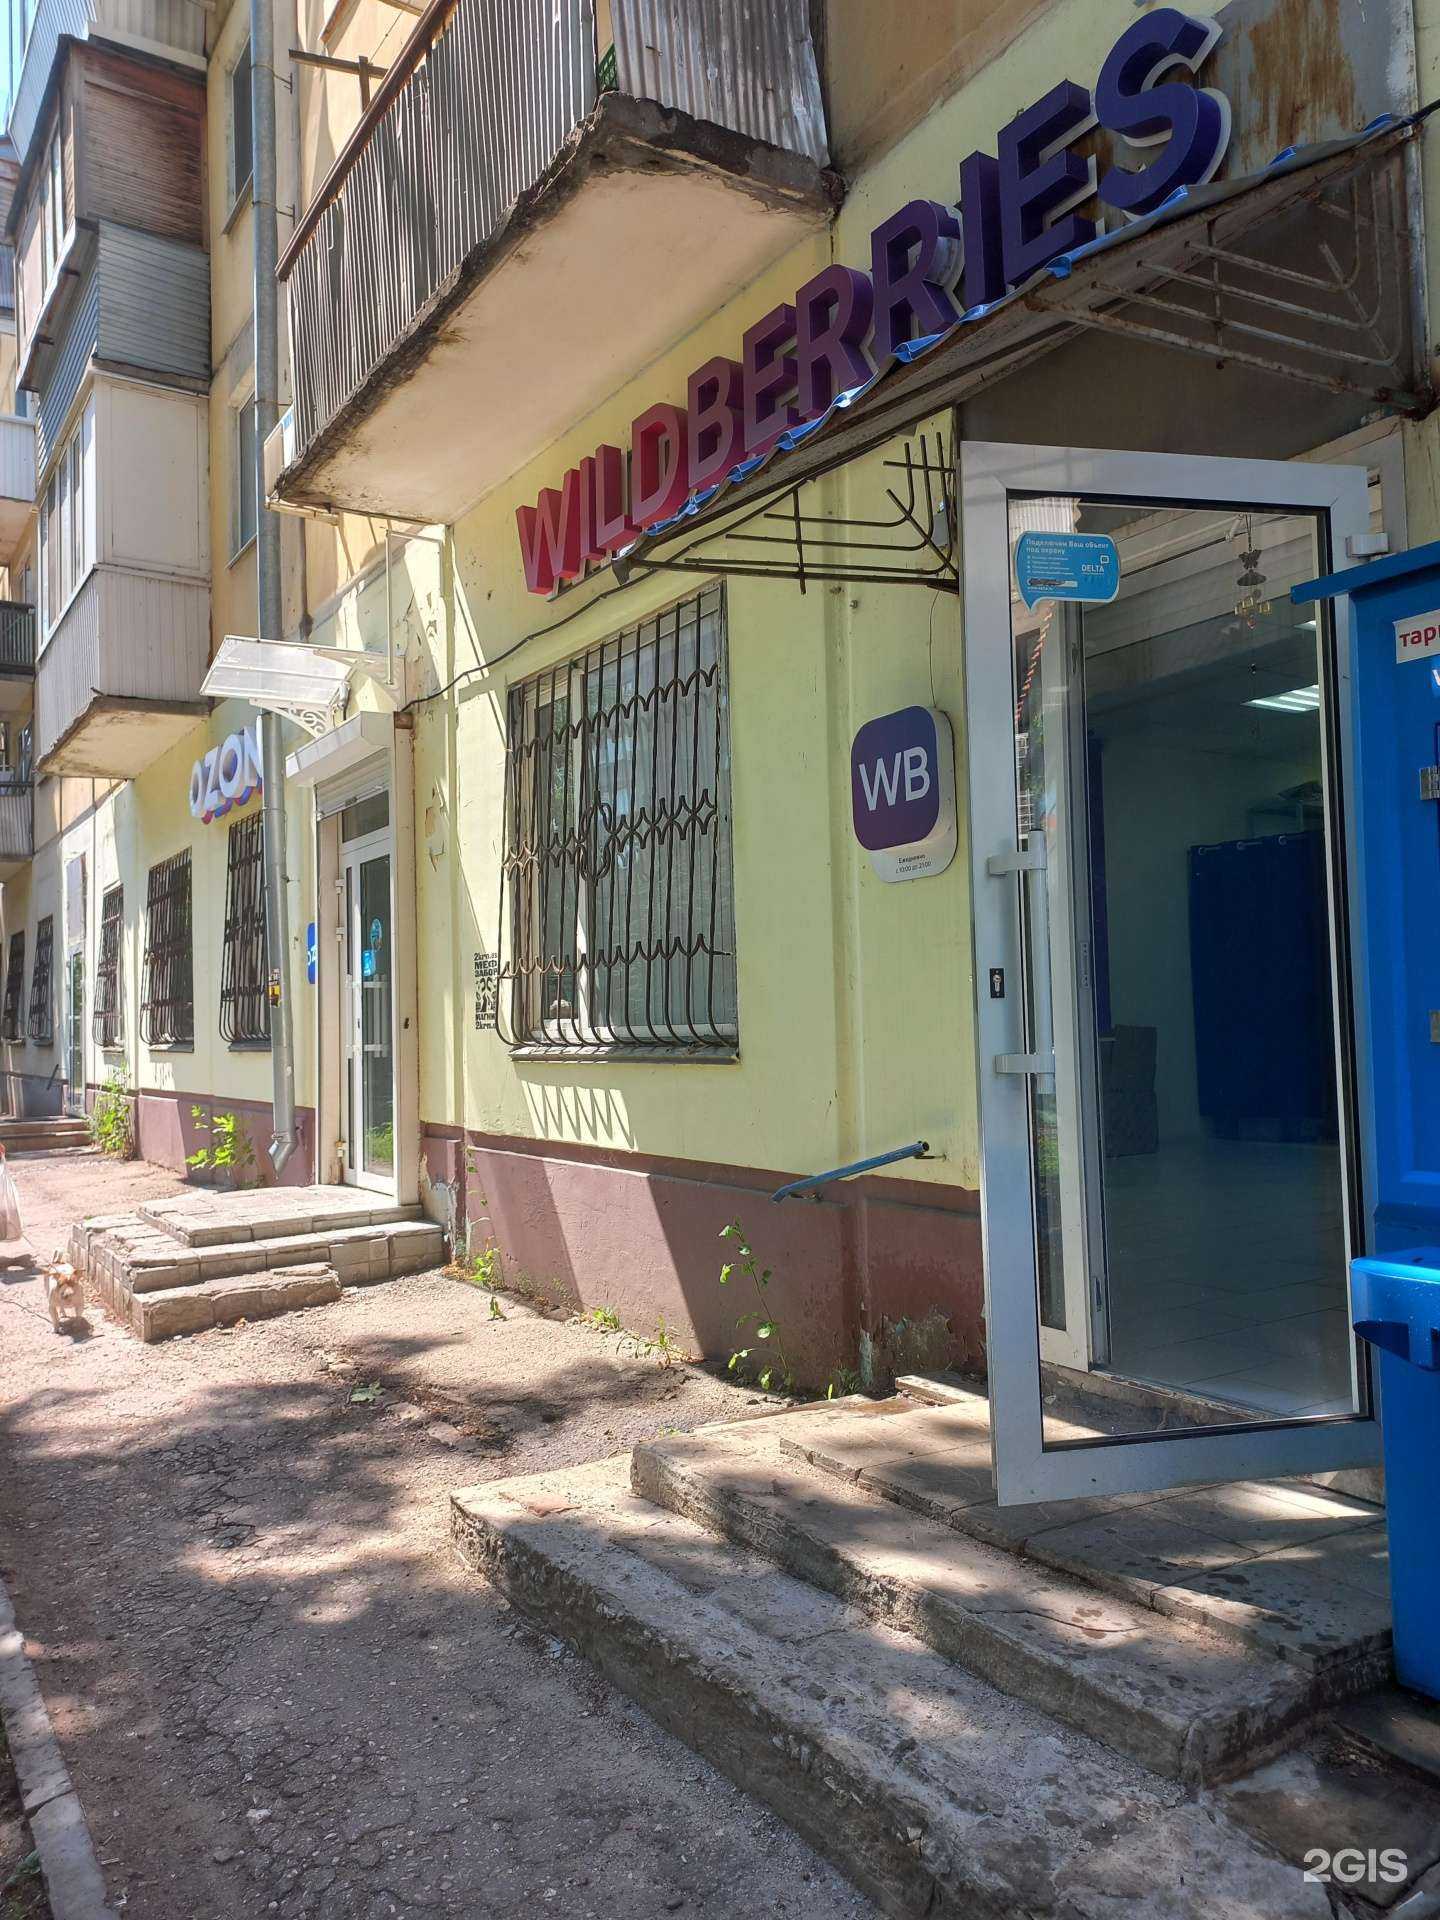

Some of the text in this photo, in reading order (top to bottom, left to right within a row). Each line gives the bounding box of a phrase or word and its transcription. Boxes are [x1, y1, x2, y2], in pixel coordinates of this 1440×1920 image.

[515, 8, 1228, 594] WILDBERRIES
[1081, 564, 1105, 573] DELTA
[1399, 624, 1440, 648] тар
[190, 715, 263, 818] OZON
[858, 746, 931, 811] WB
[474, 959, 498, 970] МЕФ
